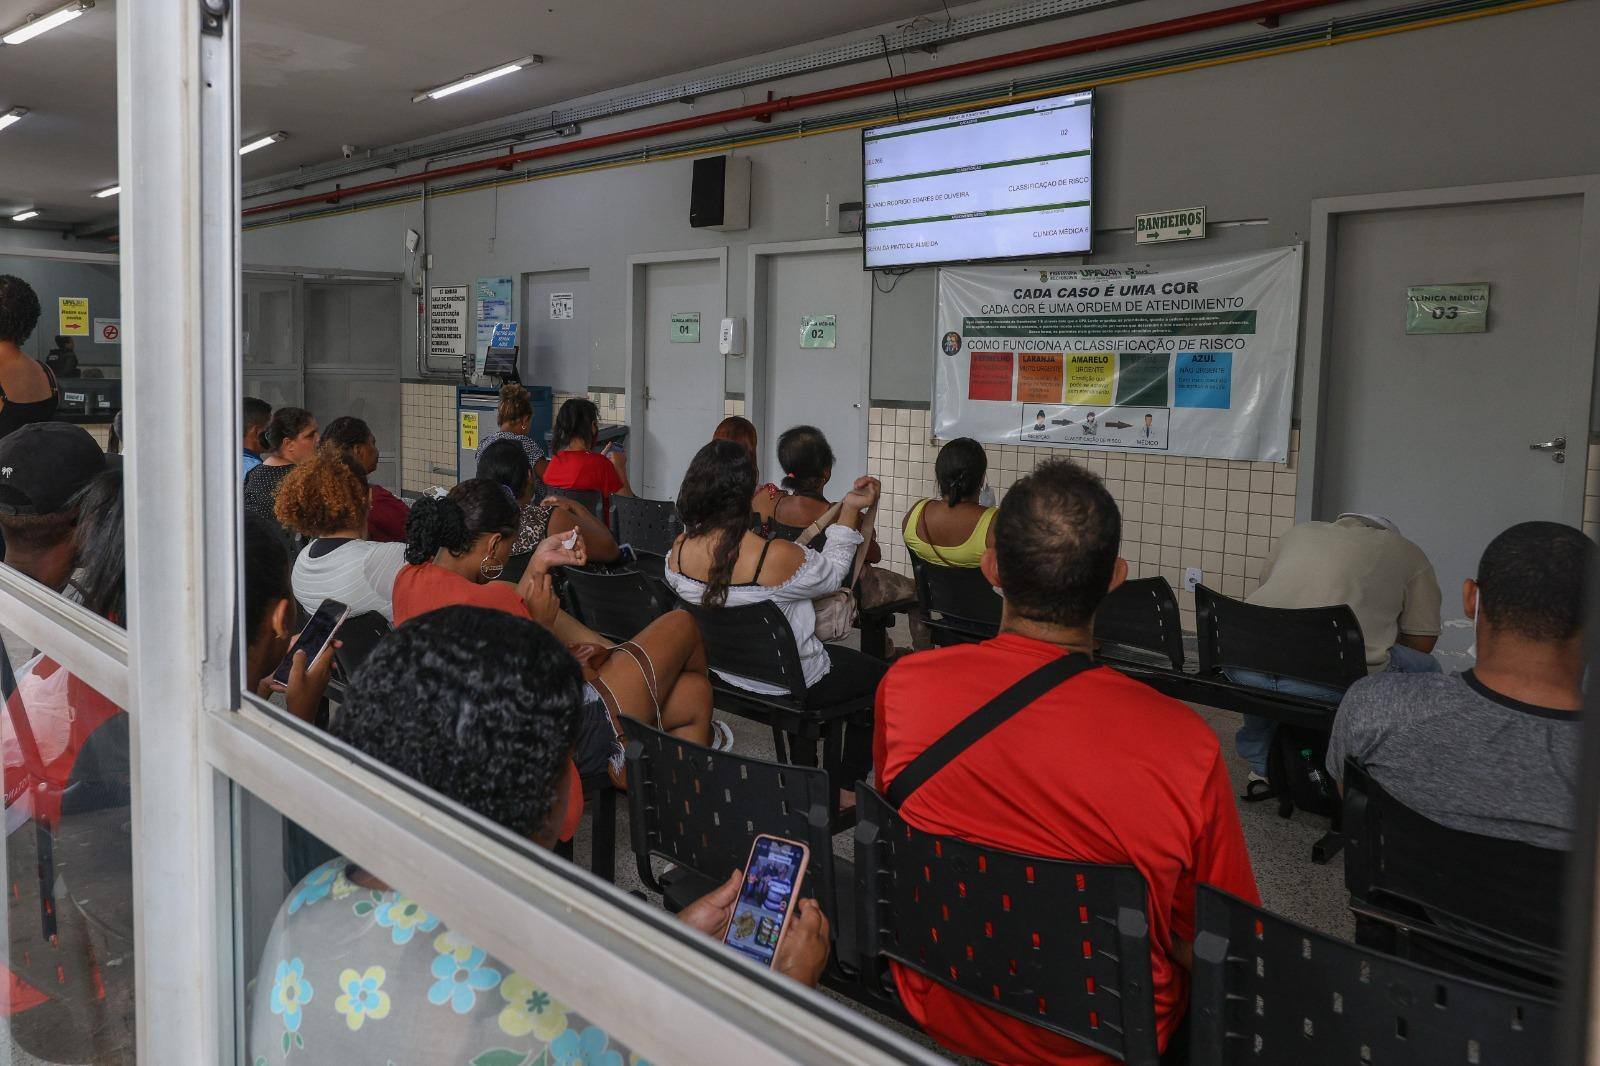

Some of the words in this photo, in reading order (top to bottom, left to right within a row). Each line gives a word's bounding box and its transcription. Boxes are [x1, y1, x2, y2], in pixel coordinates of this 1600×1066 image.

[1058, 179, 1067, 187] DE
[1068, 176, 1089, 186] RISCO
[944, 191, 970, 200] OLIVEIRA
[1137, 211, 1202, 231] BANHEIROS
[1013, 288, 1052, 299] CADA
[1057, 286, 1099, 298] CASO
[1104, 283, 1115, 297] É
[1119, 284, 1156, 297] UMA
[1161, 281, 1200, 295] COR
[981, 304, 1009, 315] CADA
[1011, 303, 1035, 314] COR
[1038, 302, 1046, 313] É
[1048, 302, 1075, 313] UMA
[1076, 301, 1121, 313] ORDEM
[1125, 301, 1142, 312] DE
[1145, 296, 1244, 312] ATENDIMENTO
[1432, 306, 1459, 320] 03
[679, 325, 689, 335] 01
[811, 329, 824, 339] 02
[967, 340, 1000, 350] COMO
[1003, 339, 1063, 351] FUNCIONA
[1063, 340, 1072, 350] A
[1074, 338, 1175, 353] CLASSIFICAÇÃO
[1178, 339, 1195, 350] DE
[1200, 338, 1245, 350] RISCO
[1022, 355, 1056, 363] LARANJA
[1192, 354, 1216, 363] AZUL
